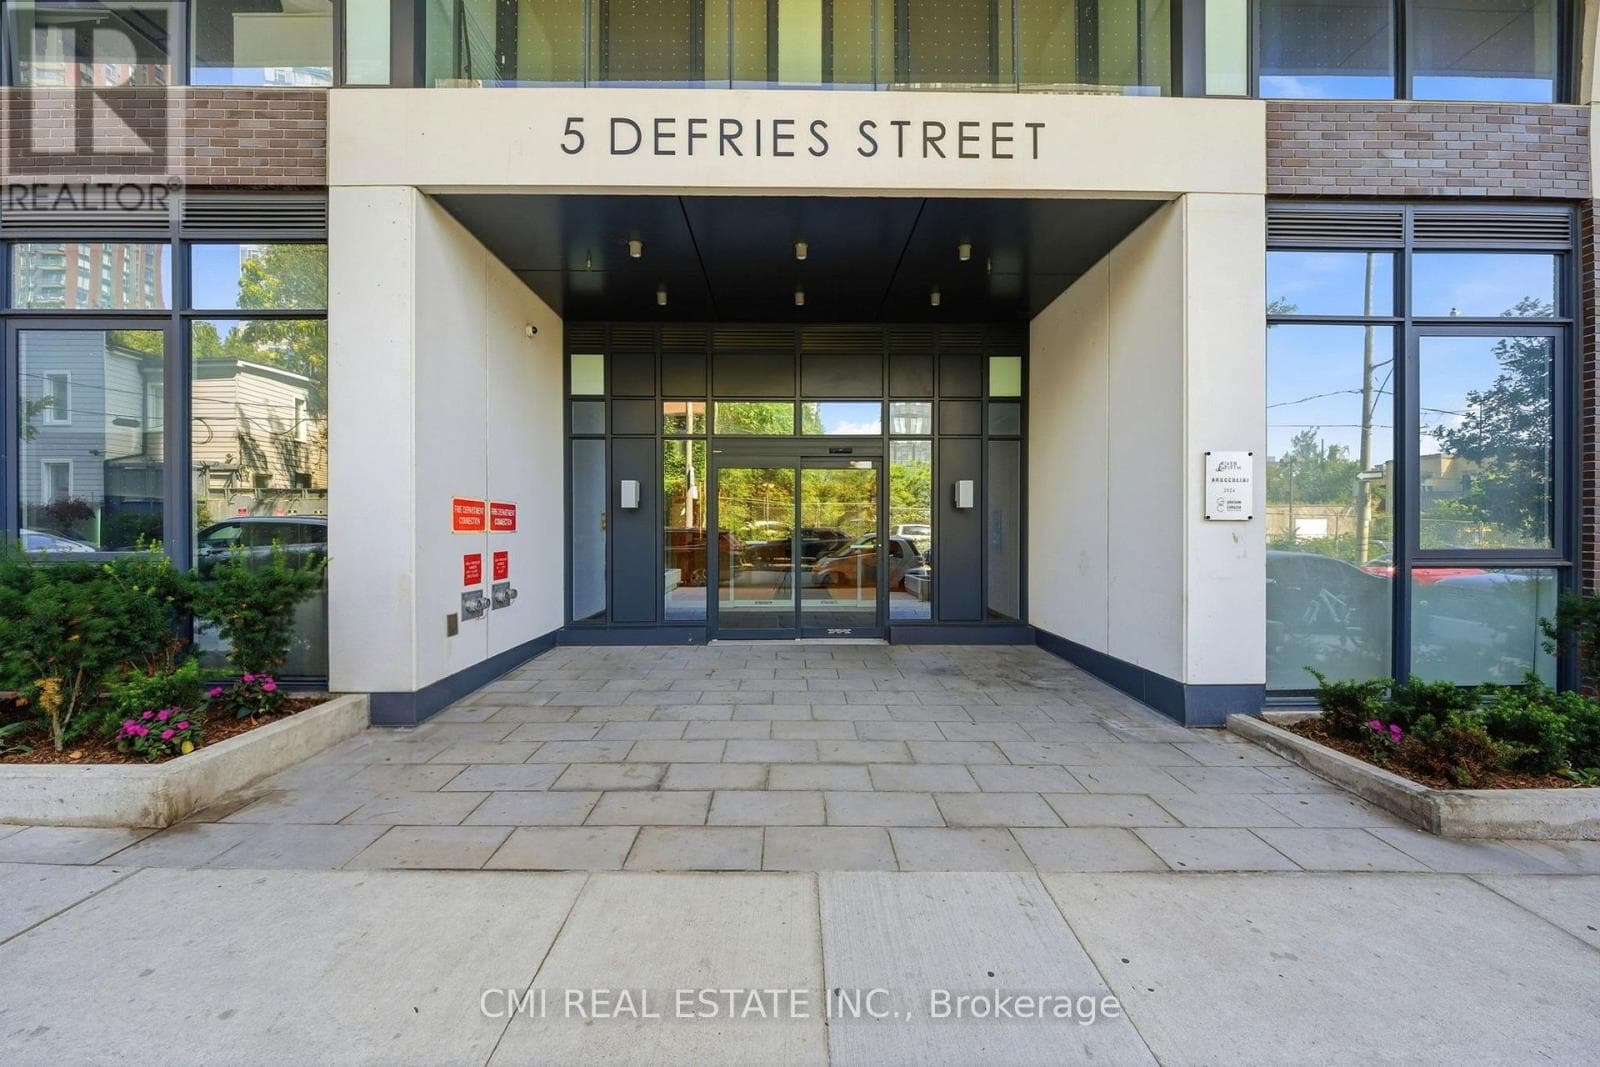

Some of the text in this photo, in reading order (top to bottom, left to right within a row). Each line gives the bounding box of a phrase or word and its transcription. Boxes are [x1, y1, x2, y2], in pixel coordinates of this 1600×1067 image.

[560, 117, 1046, 160] 5 DEFRIES STREET
